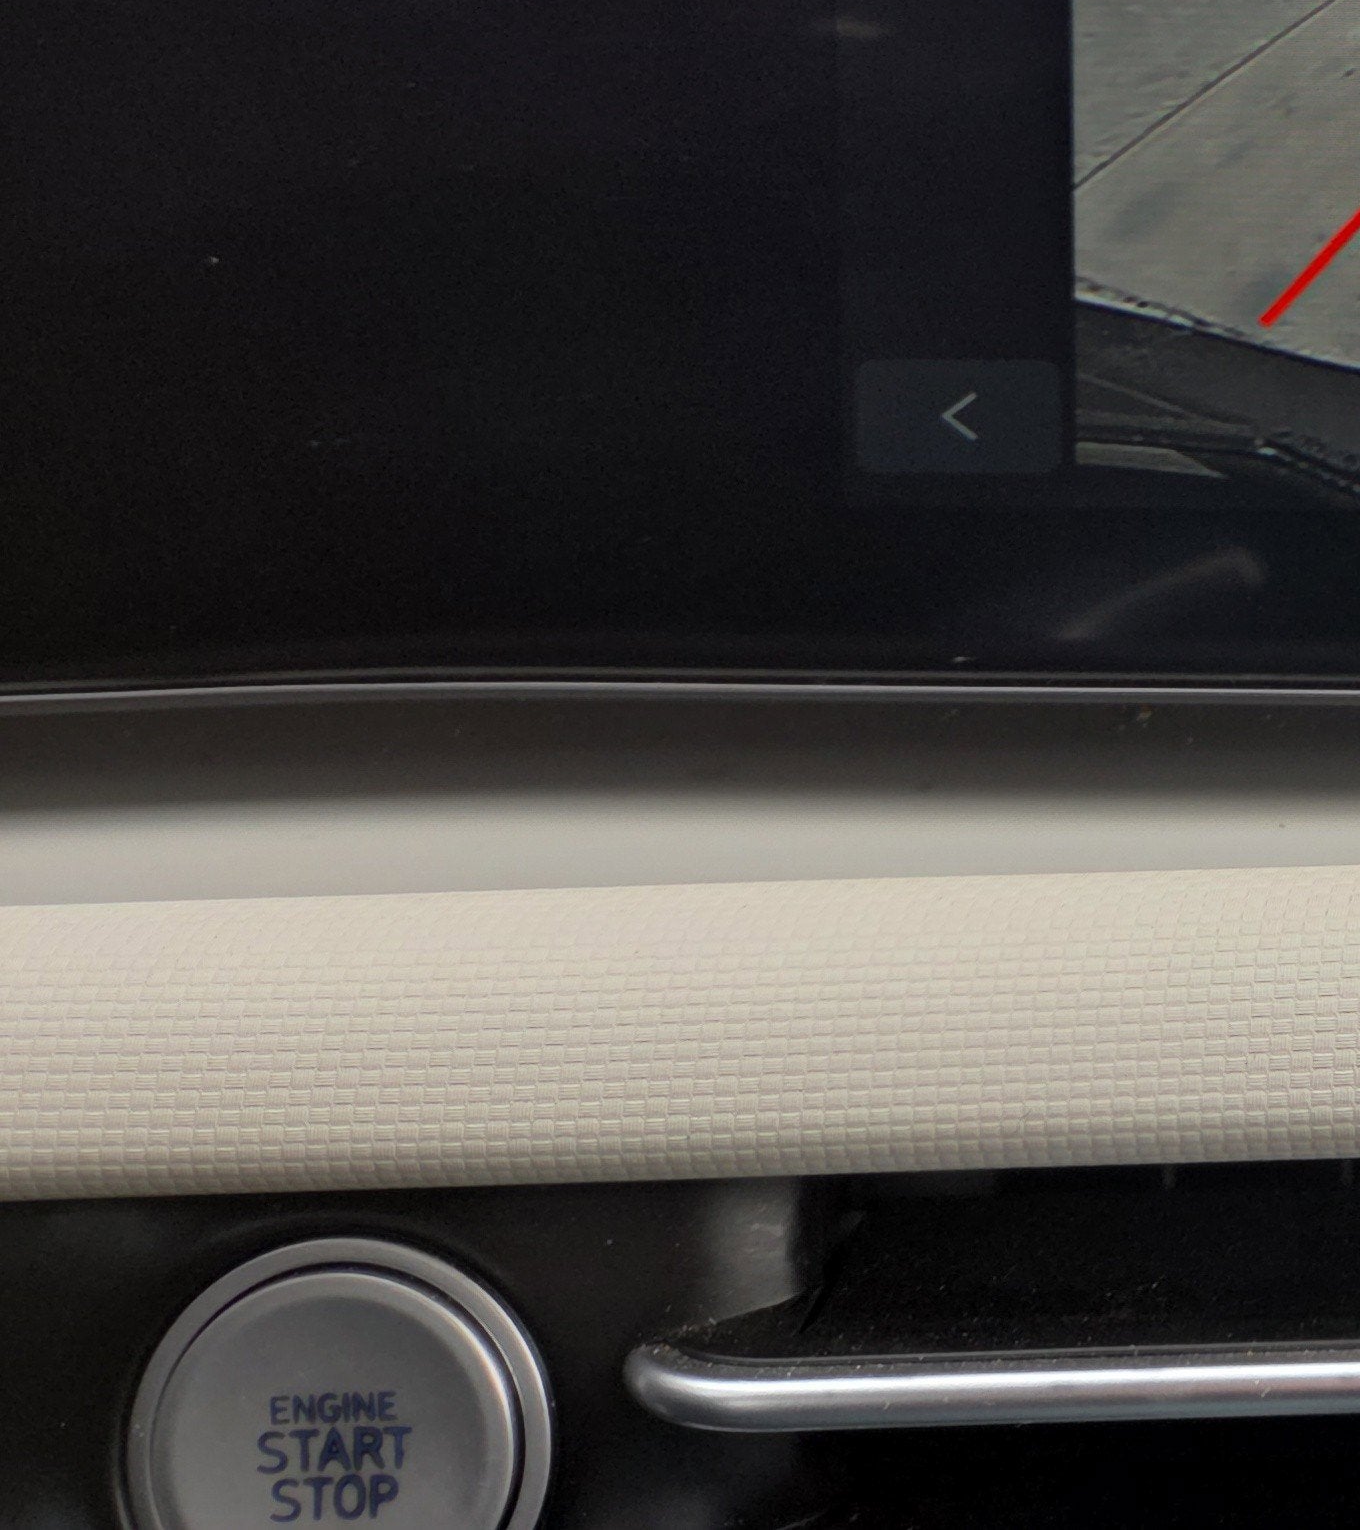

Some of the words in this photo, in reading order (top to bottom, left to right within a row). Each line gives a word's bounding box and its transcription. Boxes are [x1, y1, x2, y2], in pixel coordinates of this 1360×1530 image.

[269, 1390, 398, 1425] ENGINE
[256, 1425, 413, 1475] START
[269, 1473, 400, 1522] STOP
